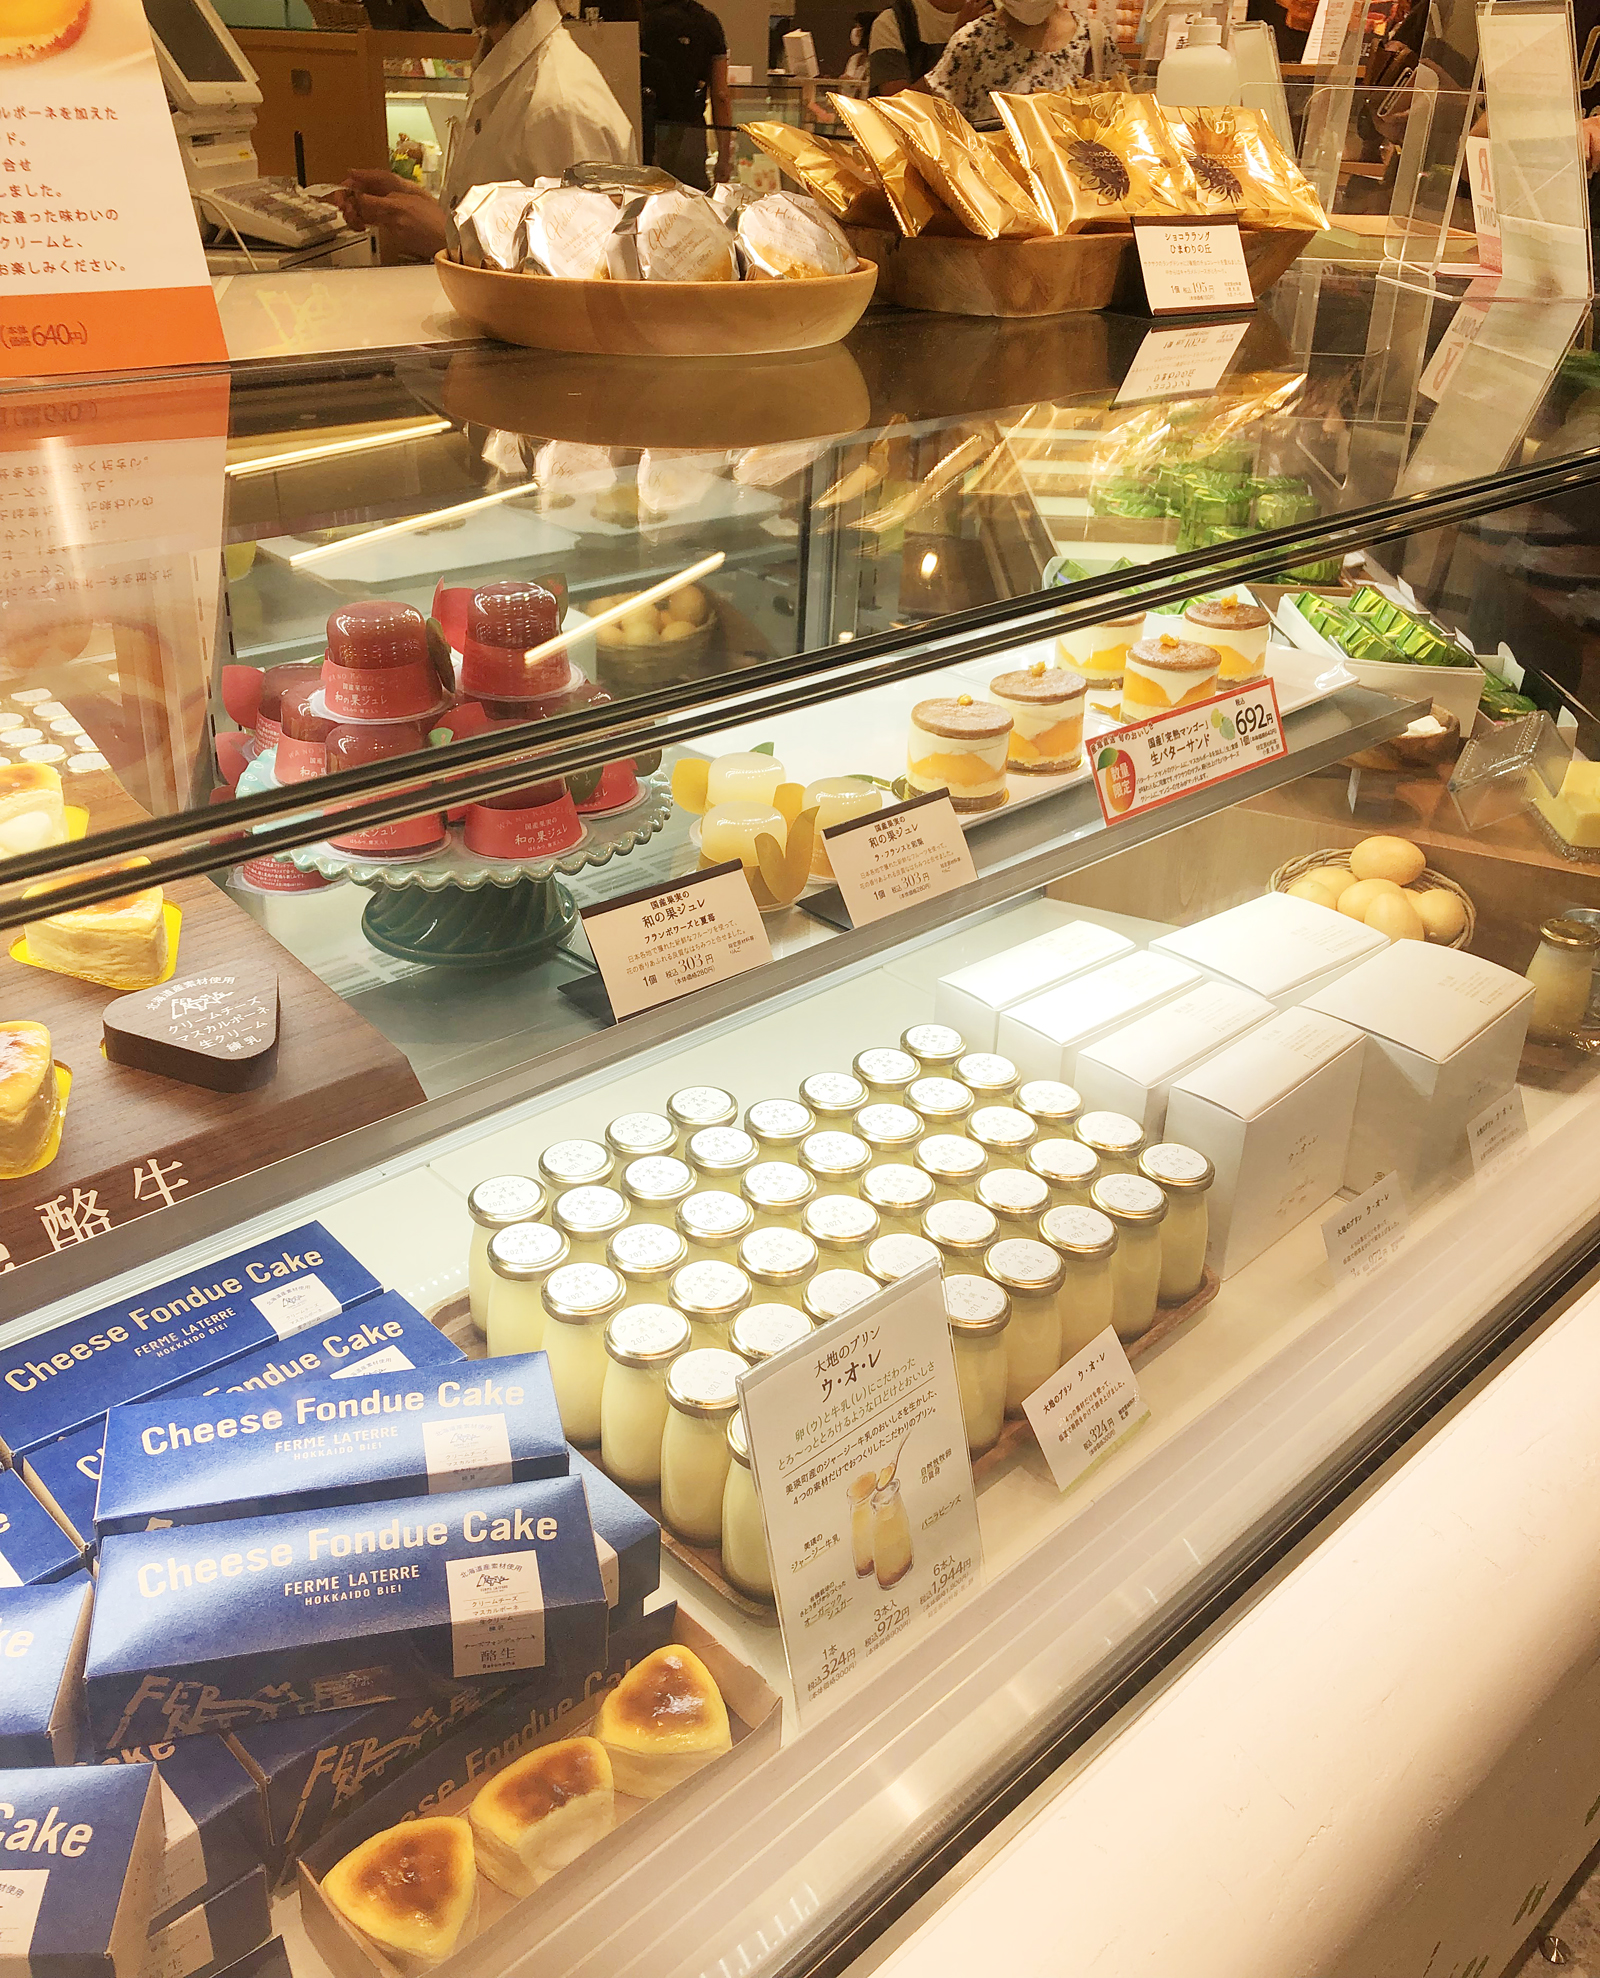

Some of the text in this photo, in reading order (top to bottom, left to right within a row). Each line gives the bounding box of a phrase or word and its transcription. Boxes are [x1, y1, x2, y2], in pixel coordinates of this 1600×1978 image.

[2, 158, 31, 172] 合せ
[1170, 243, 1213, 255] ひまわりの丘
[334, 690, 388, 706] 和の果ジュレ
[1235, 696, 1246, 708] 税込
[1234, 702, 1275, 737] 692円
[1150, 733, 1210, 768] 生バターサンド
[1111, 761, 1131, 782] 数量
[1111, 780, 1132, 800] 限定
[514, 823, 568, 846] 和の果ジュレ
[868, 822, 920, 850] 和の果ジュレ
[874, 815, 906, 833] 国産果実の
[649, 890, 690, 911] 国産果実の
[873, 889, 887, 901] 1個
[641, 898, 706, 930] 和の果ジュレ
[145, 975, 237, 1012] 北海道産素材使用
[642, 974, 659, 988] 1個
[167, 995, 263, 1035] クリームチーズ
[175, 1005, 271, 1043] マスカルポーネ
[199, 1019, 268, 1051] 生クリーム
[4, 1249, 325, 1393] Cheese Fondue Cake
[134, 1306, 237, 1358] FERME LATERRE
[155, 1321, 230, 1359] HOKKAIDO BIEI
[322, 1320, 405, 1359] Cake
[814, 1325, 881, 1379] 大地のプリン
[822, 1348, 882, 1403] ウ・オ・レ
[1042, 1352, 1106, 1415] 大地のプリン ウ・オ・レ
[141, 1378, 526, 1456] Cheese Fondue Cake
[274, 1424, 400, 1454] FERME LATERRE
[293, 1440, 384, 1461] HOKKAIDO BIEI
[921, 1494, 963, 1530] バニラビーンズ
[137, 1509, 559, 1598] Cheese Fondue Cake
[790, 1533, 841, 1571] ジャージー牛乳
[803, 1533, 824, 1551] 美瑛の
[460, 1562, 523, 1578] 北海道産素材使用
[932, 1554, 957, 1577] 6本入
[283, 1564, 421, 1598] FERME LATERRE
[304, 1584, 403, 1608] HOKKAIDO BIEI
[472, 1596, 518, 1608] クリームチーズ
[804, 1593, 843, 1627] オーガニック
[827, 1596, 853, 1620] シュガー
[472, 1605, 519, 1616] マスカルポーネ
[873, 1599, 898, 1623] 3本入
[823, 1643, 839, 1662] 1本
